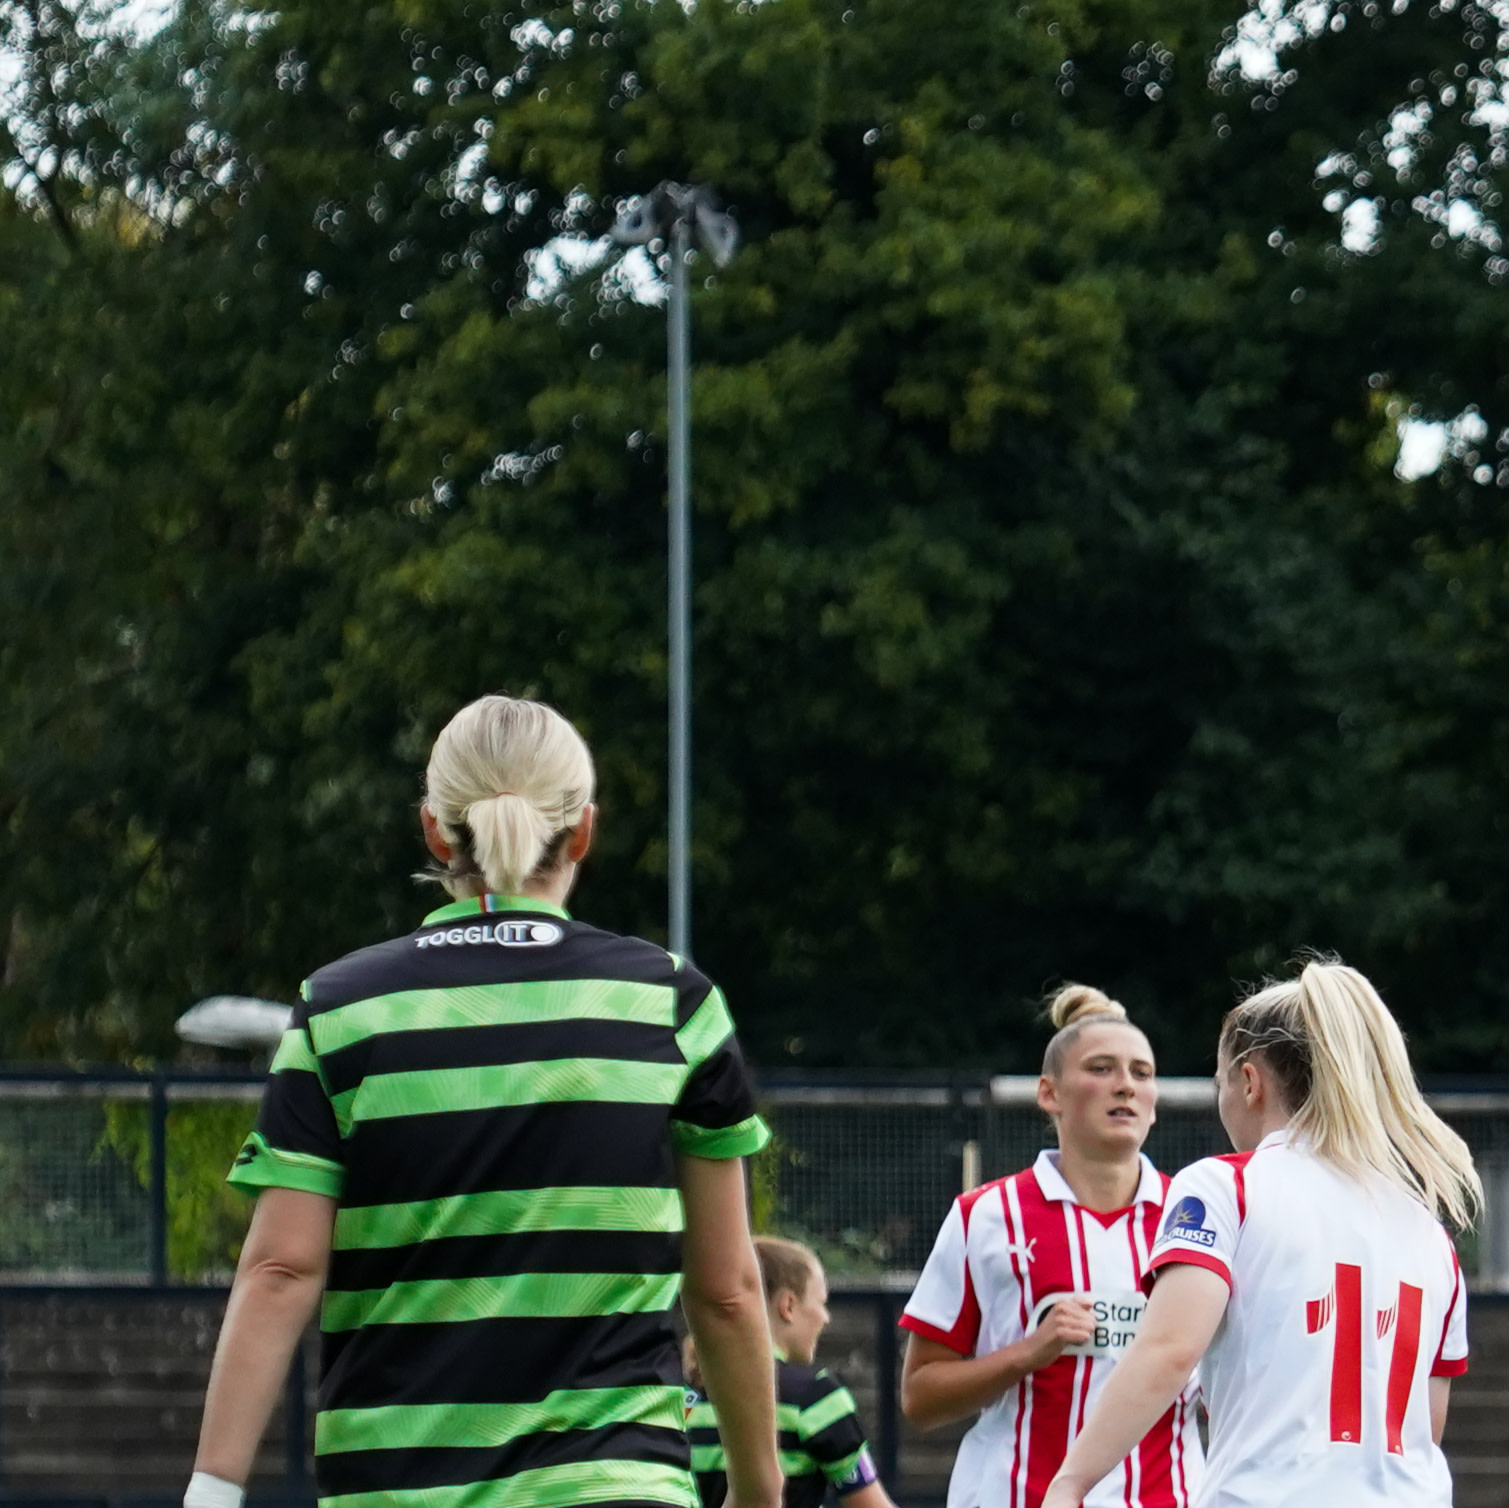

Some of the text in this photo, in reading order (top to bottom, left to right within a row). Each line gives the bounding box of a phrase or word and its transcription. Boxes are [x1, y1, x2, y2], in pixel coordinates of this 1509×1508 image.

[1093, 1301, 1148, 1322] Star
[1094, 1327, 1135, 1347] Ban
[1306, 1262, 1423, 1456] 11
